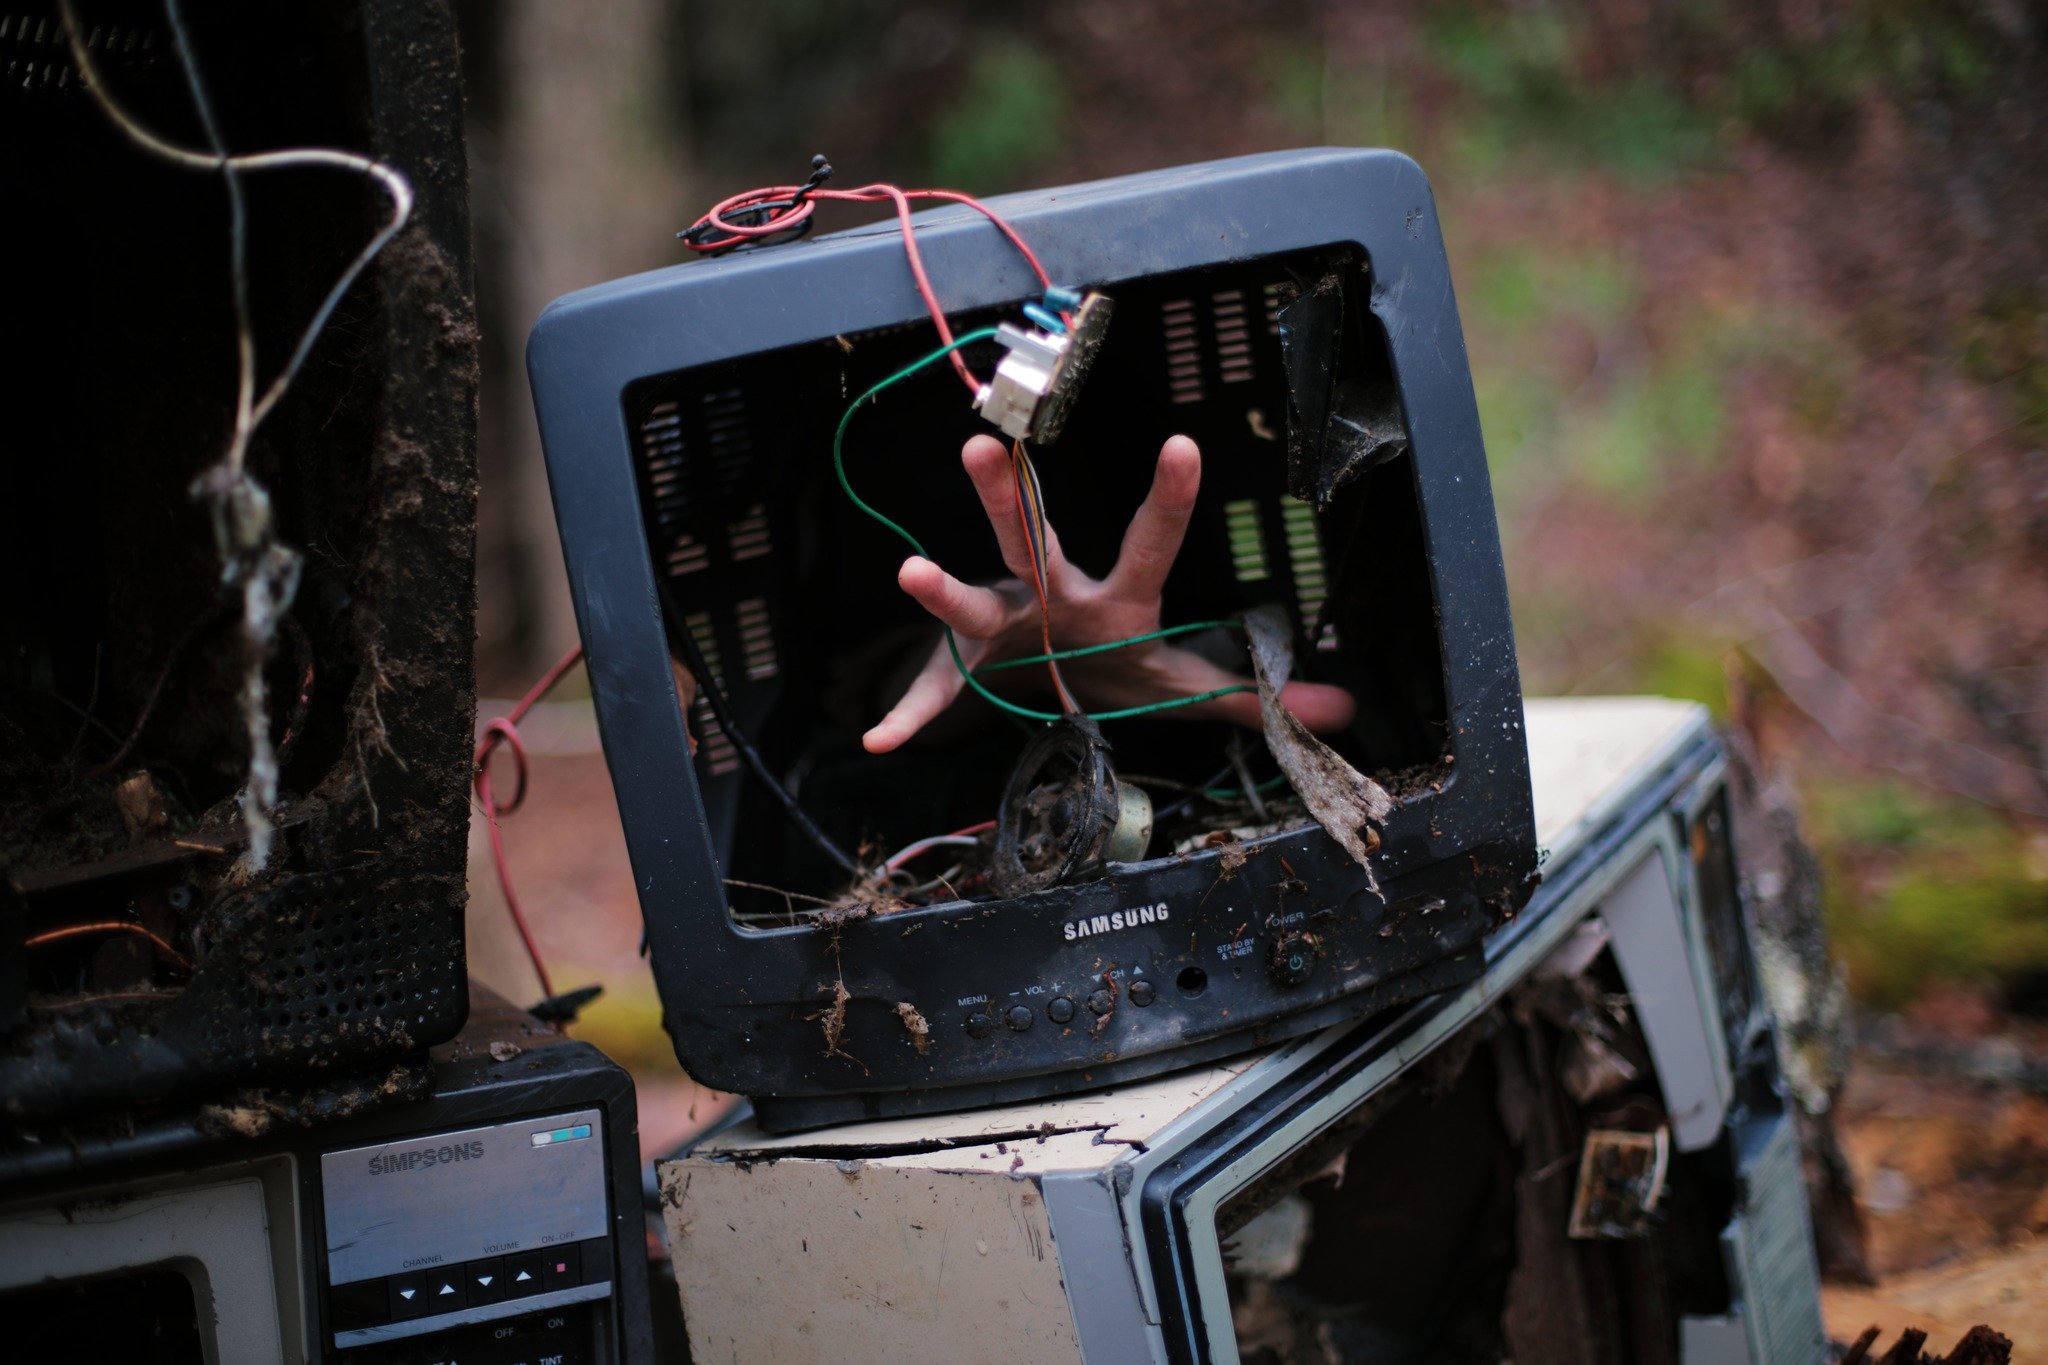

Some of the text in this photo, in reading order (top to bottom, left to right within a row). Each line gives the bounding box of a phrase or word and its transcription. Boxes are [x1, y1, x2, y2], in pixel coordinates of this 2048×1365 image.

[1064, 902, 1169, 940] SAMSUNG
[1264, 911, 1304, 928] OWER
[1243, 937, 1255, 948] BY
[1221, 951, 1229, 961] &
[1110, 969, 1125, 979] CH
[1025, 985, 1046, 996] VOL
[957, 994, 988, 1007] MENU
[368, 1140, 485, 1176] SIMPSONS
[402, 1231, 576, 1269] CHANNEL VOLUME ON-OFF
[494, 1317, 564, 1340] OFF ON
[538, 1355, 564, 1365] TINT
